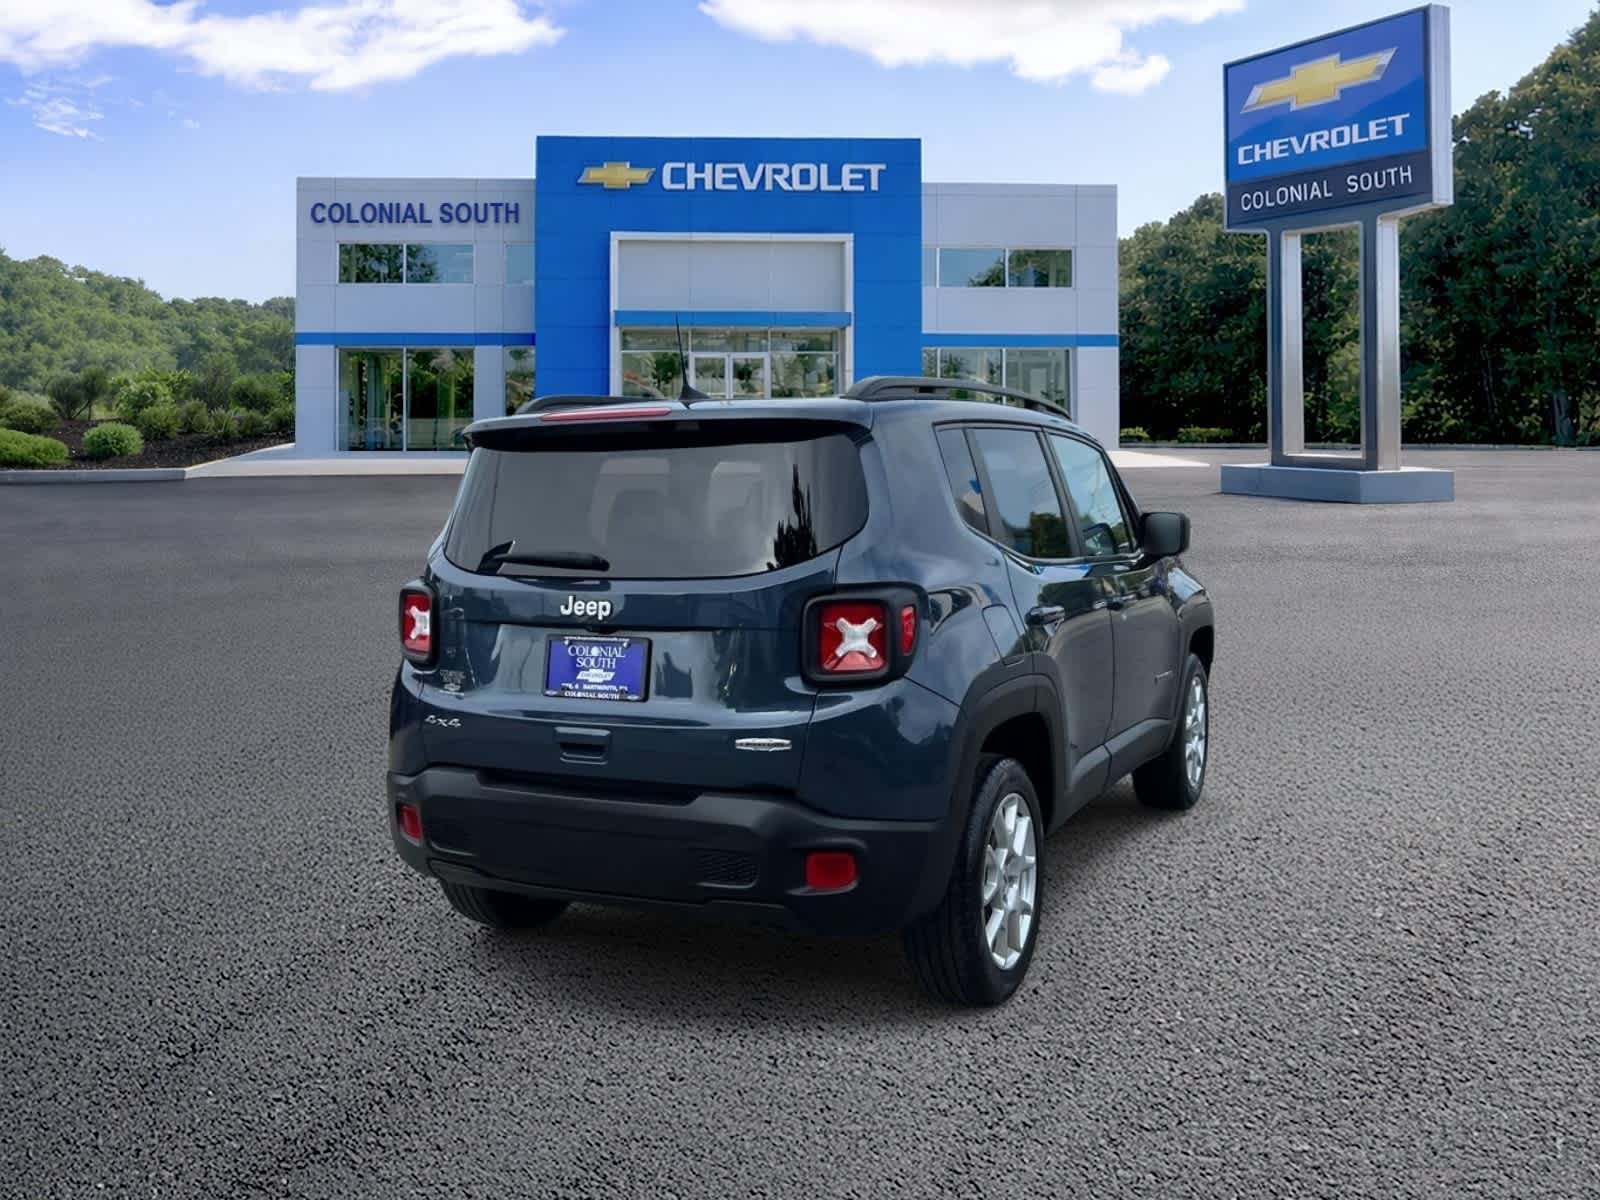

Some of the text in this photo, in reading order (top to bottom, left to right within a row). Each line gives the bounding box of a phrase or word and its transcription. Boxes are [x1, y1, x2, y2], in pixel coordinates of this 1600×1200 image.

[1237, 113, 1410, 165] CHEVROLET
[661, 162, 887, 192] CHEVROLET
[1240, 165, 1412, 211] COLONIAL SOUTH
[310, 202, 521, 225] COLONIAL SOUTH
[560, 595, 611, 620] Jeep
[568, 645, 625, 657] COLONIAL
[576, 657, 616, 669] SOUTH
